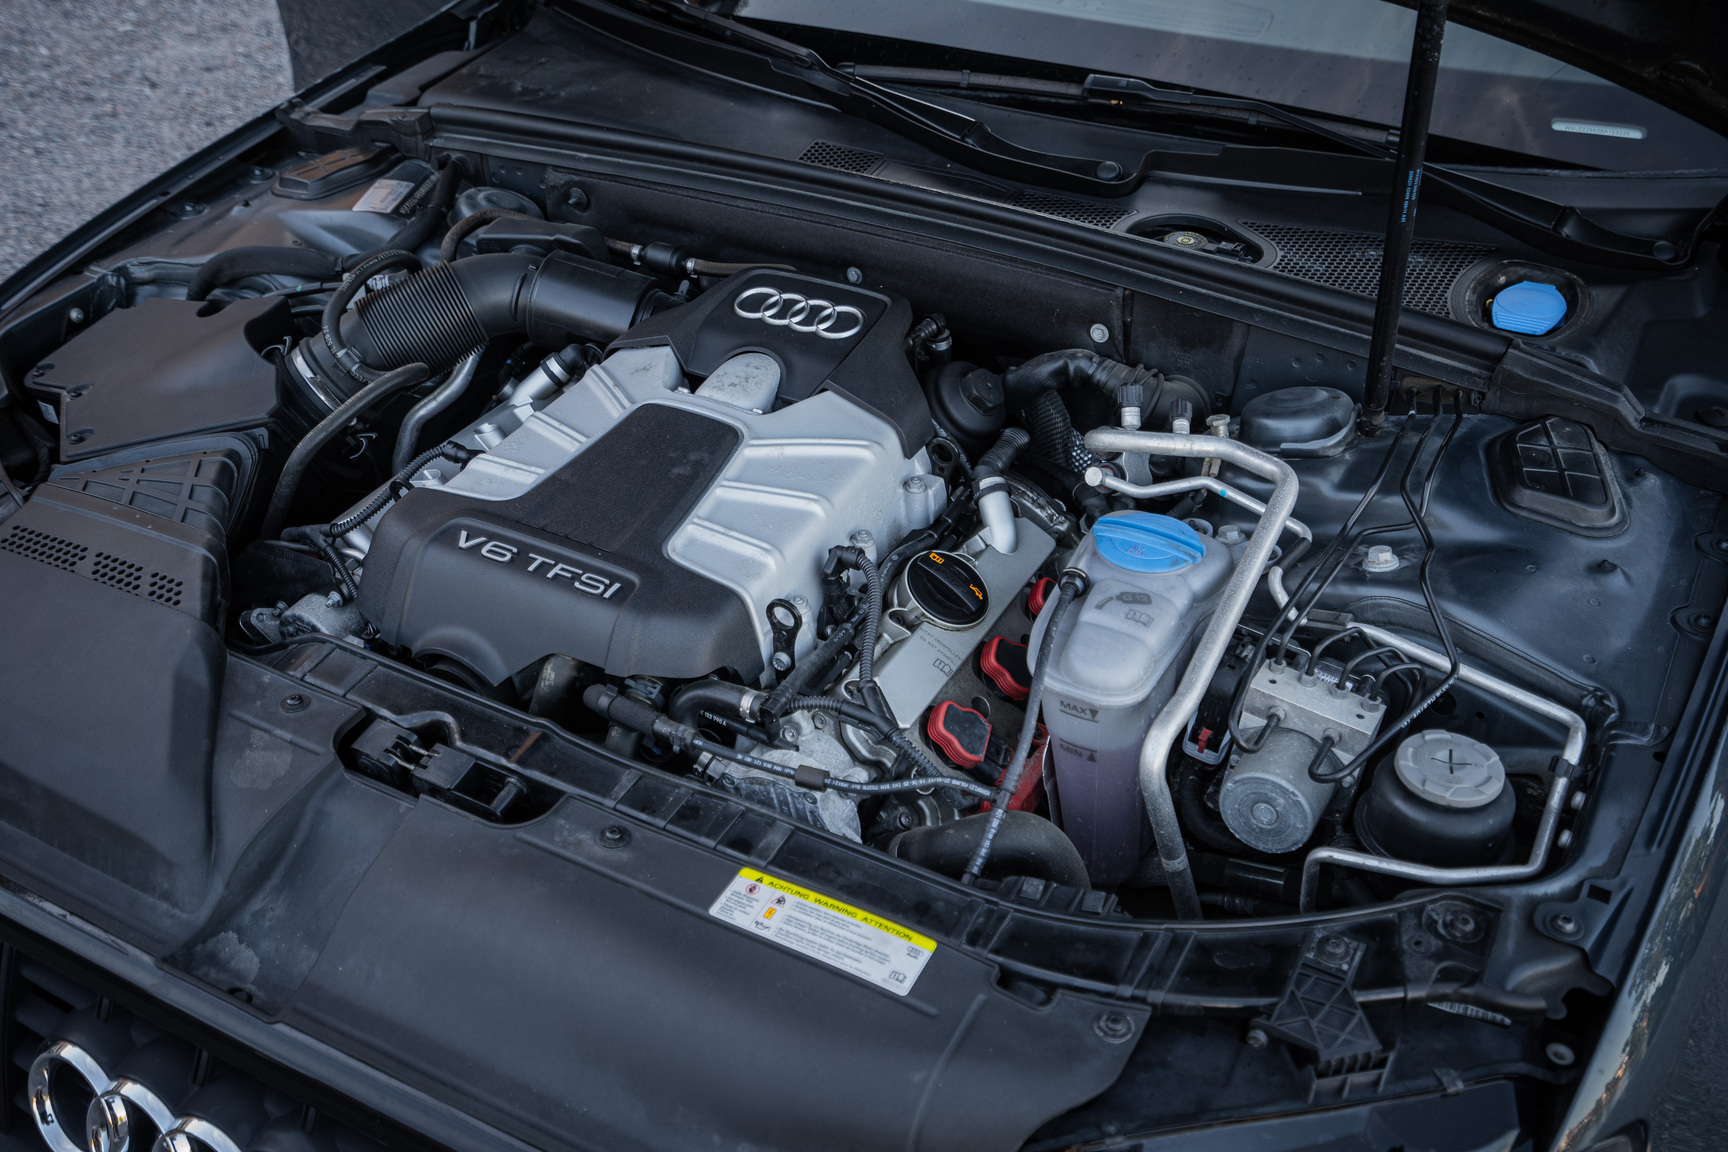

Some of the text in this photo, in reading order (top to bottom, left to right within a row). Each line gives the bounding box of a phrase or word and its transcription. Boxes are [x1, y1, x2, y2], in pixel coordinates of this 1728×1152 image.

[458, 530, 622, 600] V6 TFSI
[1060, 700, 1088, 716] MAX
[1060, 743, 1083, 759] MIN
[767, 881, 810, 901] ACHTUNG
[813, 897, 858, 919] WARNING
[861, 916, 914, 942] ATTENTION
